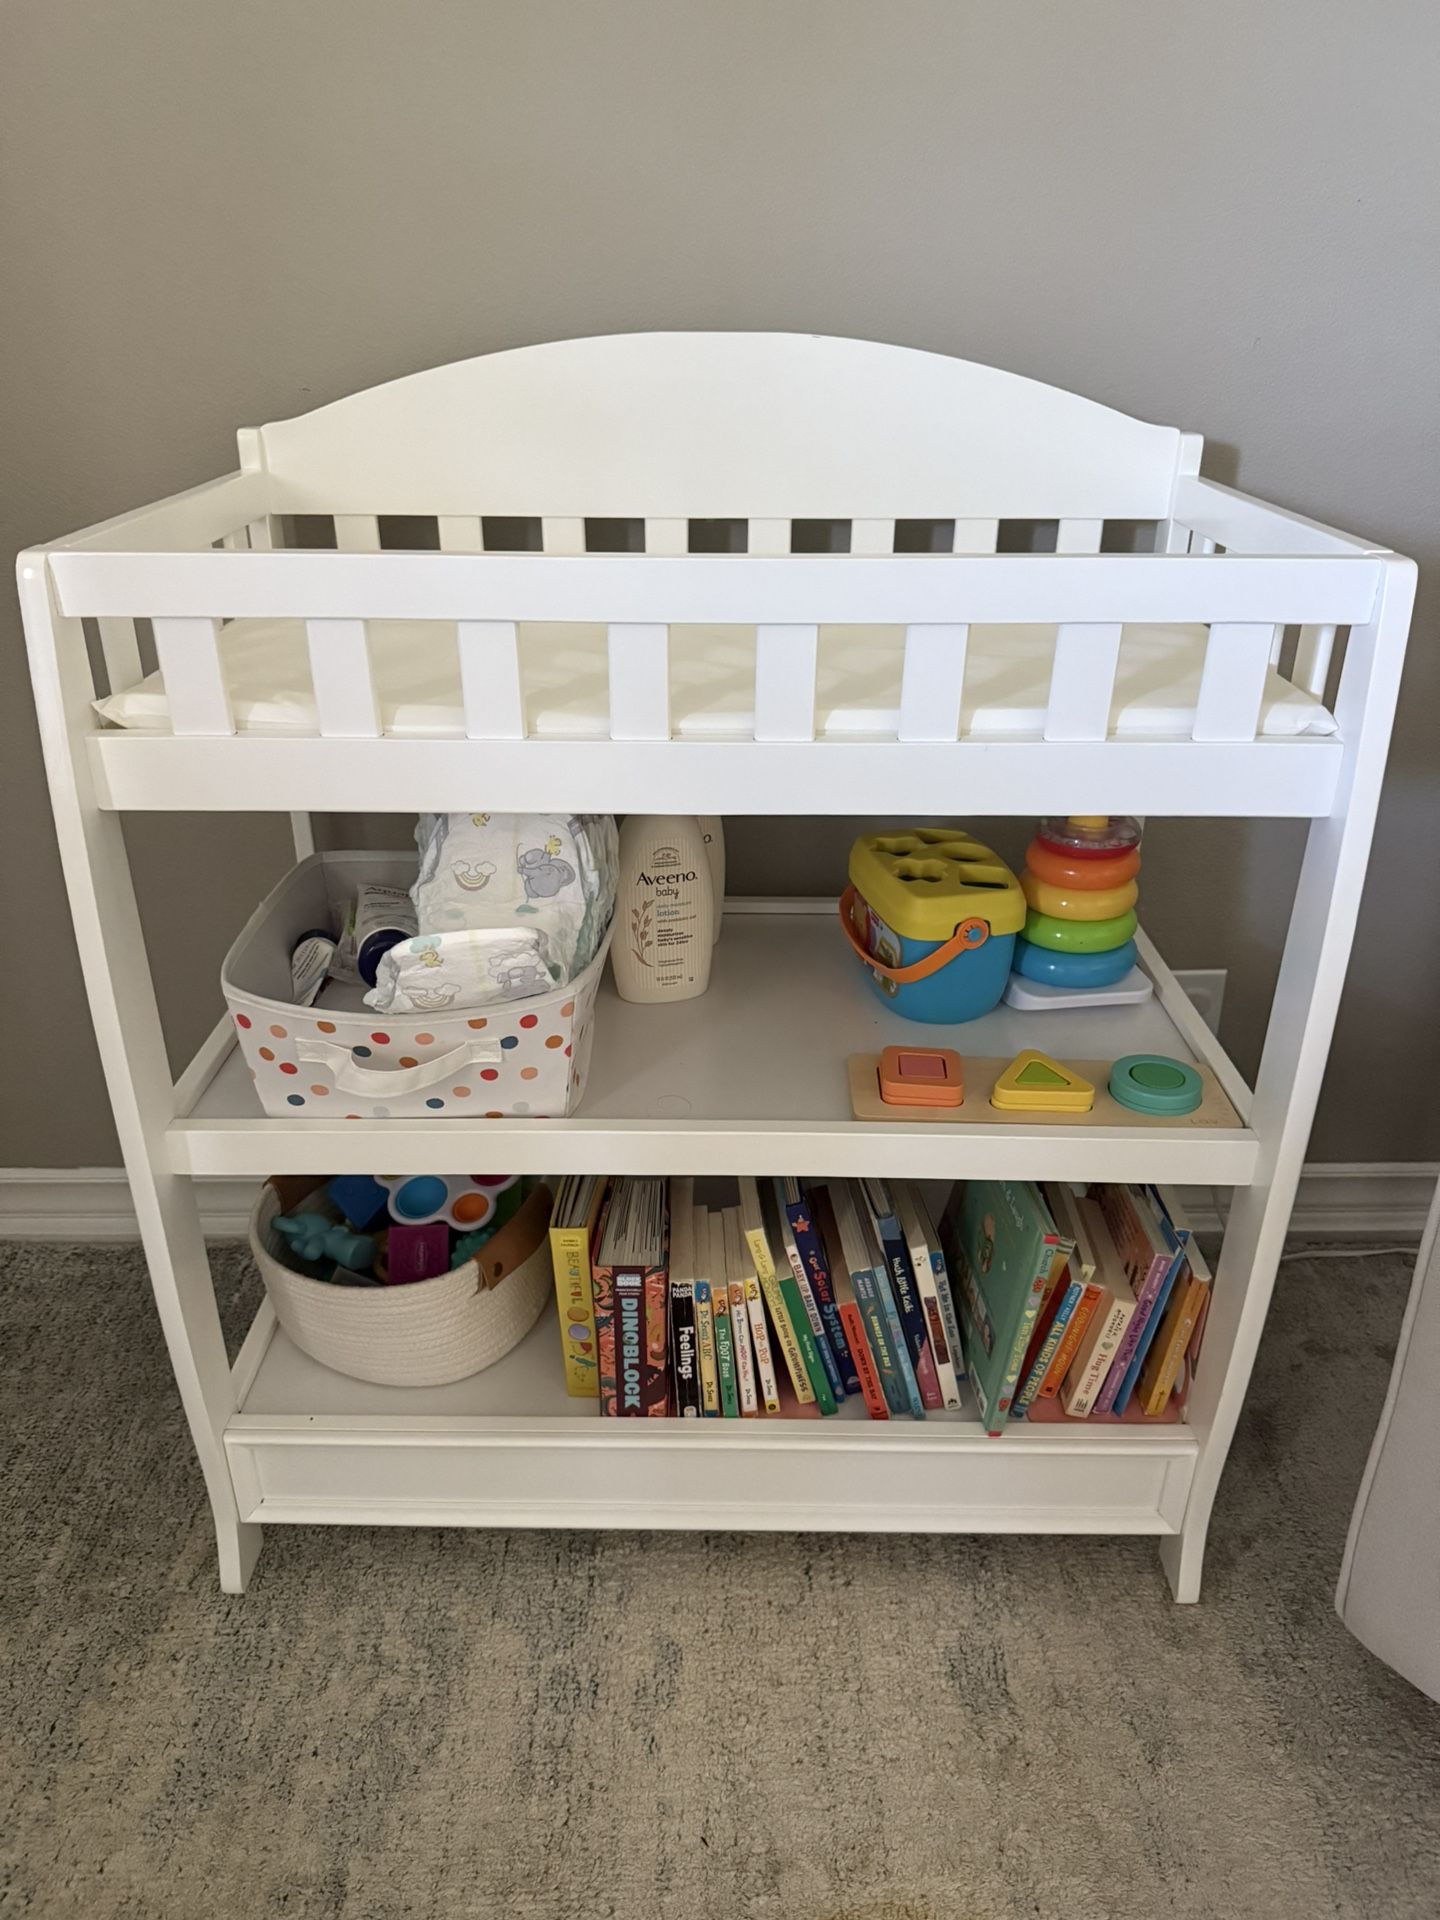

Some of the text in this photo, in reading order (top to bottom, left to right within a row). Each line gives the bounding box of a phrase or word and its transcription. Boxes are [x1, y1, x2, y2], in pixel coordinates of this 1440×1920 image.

[655, 886, 679, 899] baby
[656, 909, 680, 917] lotion
[891, 1256, 903, 1275] Hush
[1038, 1247, 1054, 1275] Church
[792, 1263, 822, 1333] BABY UP BABY DOWN
[808, 1256, 846, 1349] Our Solar System
[943, 1303, 951, 1312] in
[1138, 1298, 1152, 1317] Good
[945, 1312, 954, 1324] the
[1130, 1314, 1145, 1334] Night
[718, 1328, 726, 1340] The
[870, 1314, 882, 1338] BUNNIES
[879, 1346, 887, 1356] THE
[947, 1325, 957, 1338] Zoo
[1019, 1320, 1032, 1338] Ten
[1050, 1320, 1064, 1338] ALL
[1063, 1305, 1090, 1351] GOODNIGHT
[621, 1298, 641, 1409] DINOBLOCK
[678, 1325, 694, 1380] Feelings
[701, 1342, 712, 1360] ABC
[718, 1340, 731, 1362] FOOT
[857, 1348, 866, 1366] DOWN
[1038, 1336, 1057, 1363] KINDS
[1032, 1362, 1045, 1375] OF
[1083, 1351, 1107, 1396] Hug Time
[706, 1389, 714, 1402] Seuss
[1018, 1374, 1040, 1405] PEOPLE
